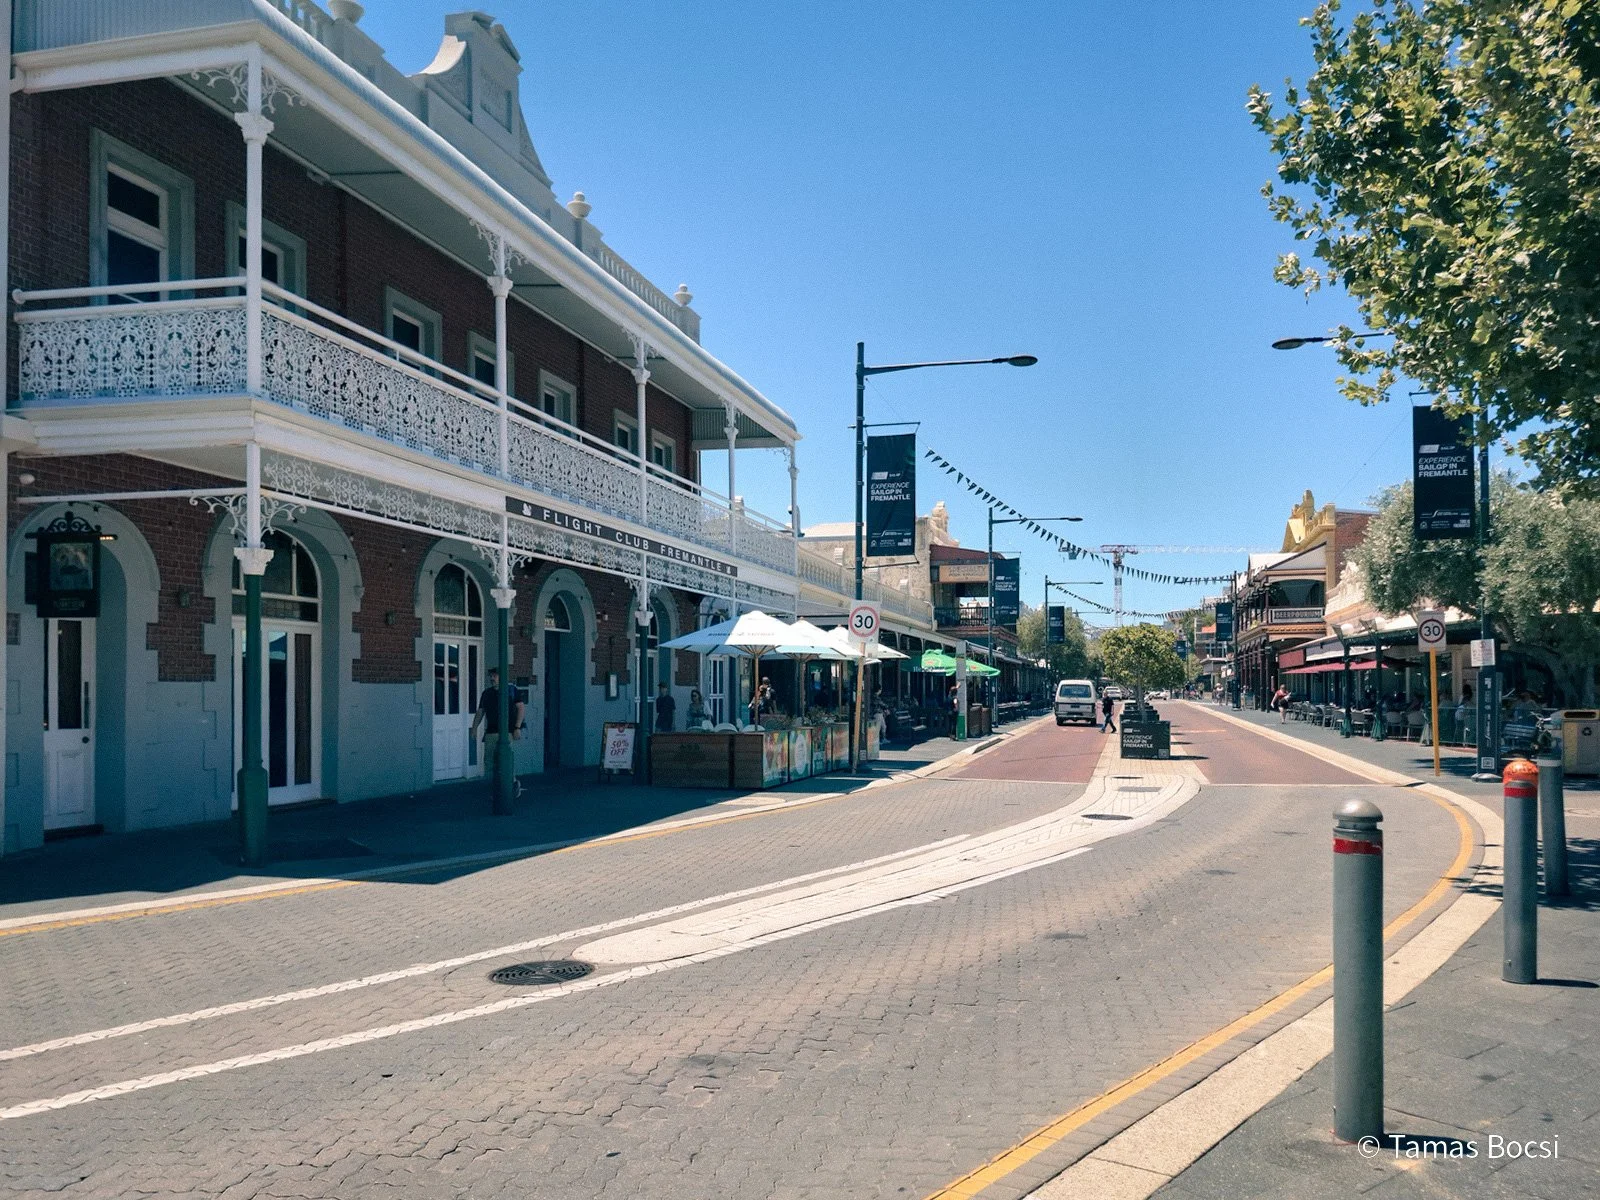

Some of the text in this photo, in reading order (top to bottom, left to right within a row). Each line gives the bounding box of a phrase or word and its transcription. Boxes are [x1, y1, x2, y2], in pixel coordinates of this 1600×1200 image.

[1418, 456, 1467, 464] EXPERIENCE
[1418, 463, 1448, 471] SAILGP
[1418, 469, 1468, 478] FREMANTLE
[542, 509, 722, 572] FLIGHT CLUB FREMANTLE
[854, 615, 874, 629] 30
[1424, 625, 1440, 636] 30
[610, 748, 629, 757] OFF
